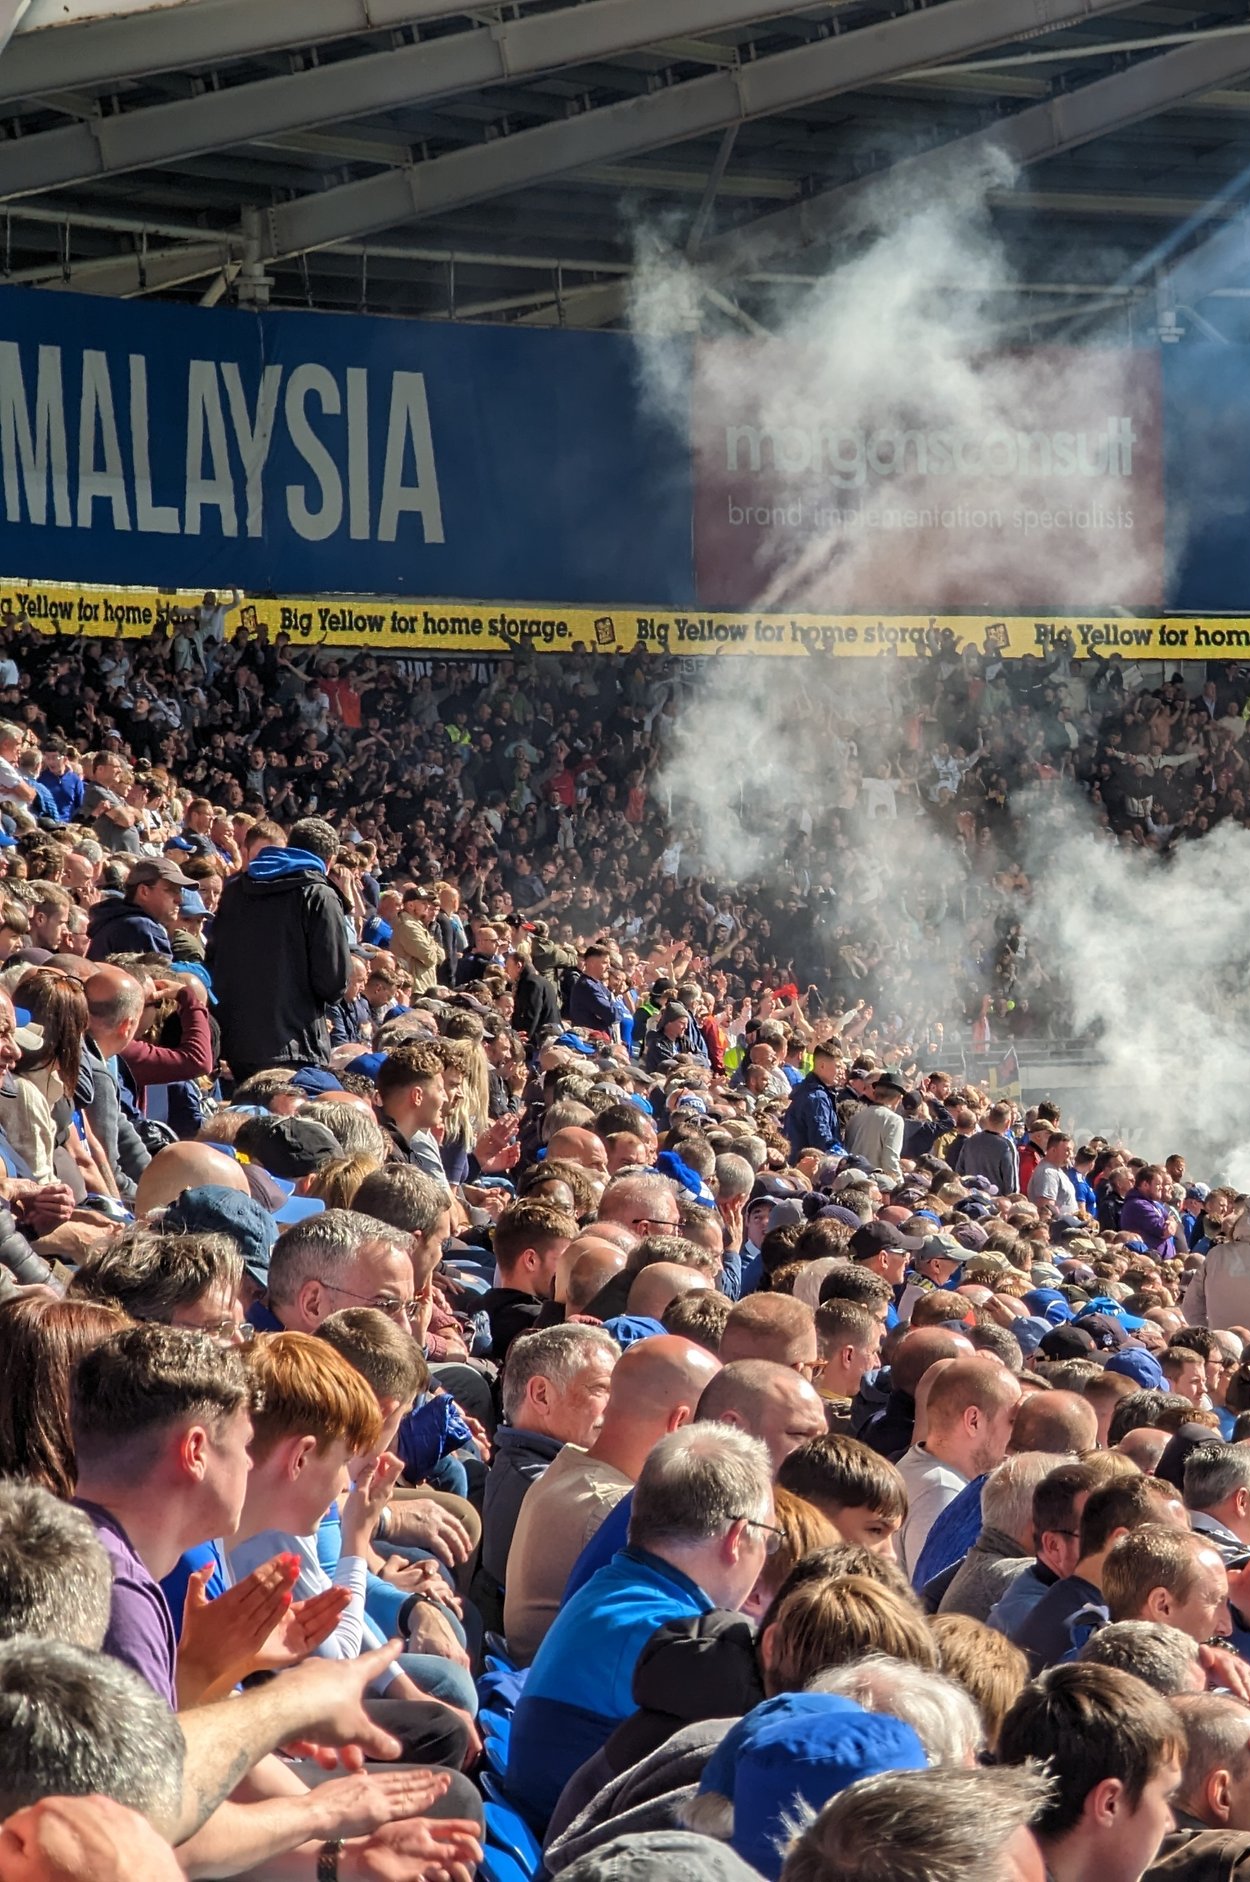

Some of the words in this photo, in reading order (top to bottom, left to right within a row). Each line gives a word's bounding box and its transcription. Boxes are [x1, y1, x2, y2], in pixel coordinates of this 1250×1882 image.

[0, 341, 446, 544] MALAYSIA
[725, 416, 1137, 489] morgansconsult
[728, 496, 801, 526] brand
[813, 499, 1001, 531] implementation
[1012, 501, 1134, 535] specialists
[16, 593, 72, 619] Yellow
[78, 597, 100, 622] for
[103, 599, 152, 625] home
[280, 608, 312, 636] Big
[318, 608, 385, 633] Yellow
[391, 611, 420, 634] for
[423, 612, 483, 636] home
[637, 618, 669, 646] Big
[675, 618, 749, 643] Yellow
[754, 619, 785, 643] for
[1077, 623, 1152, 647] Yellow
[1159, 624, 1188, 647] for
